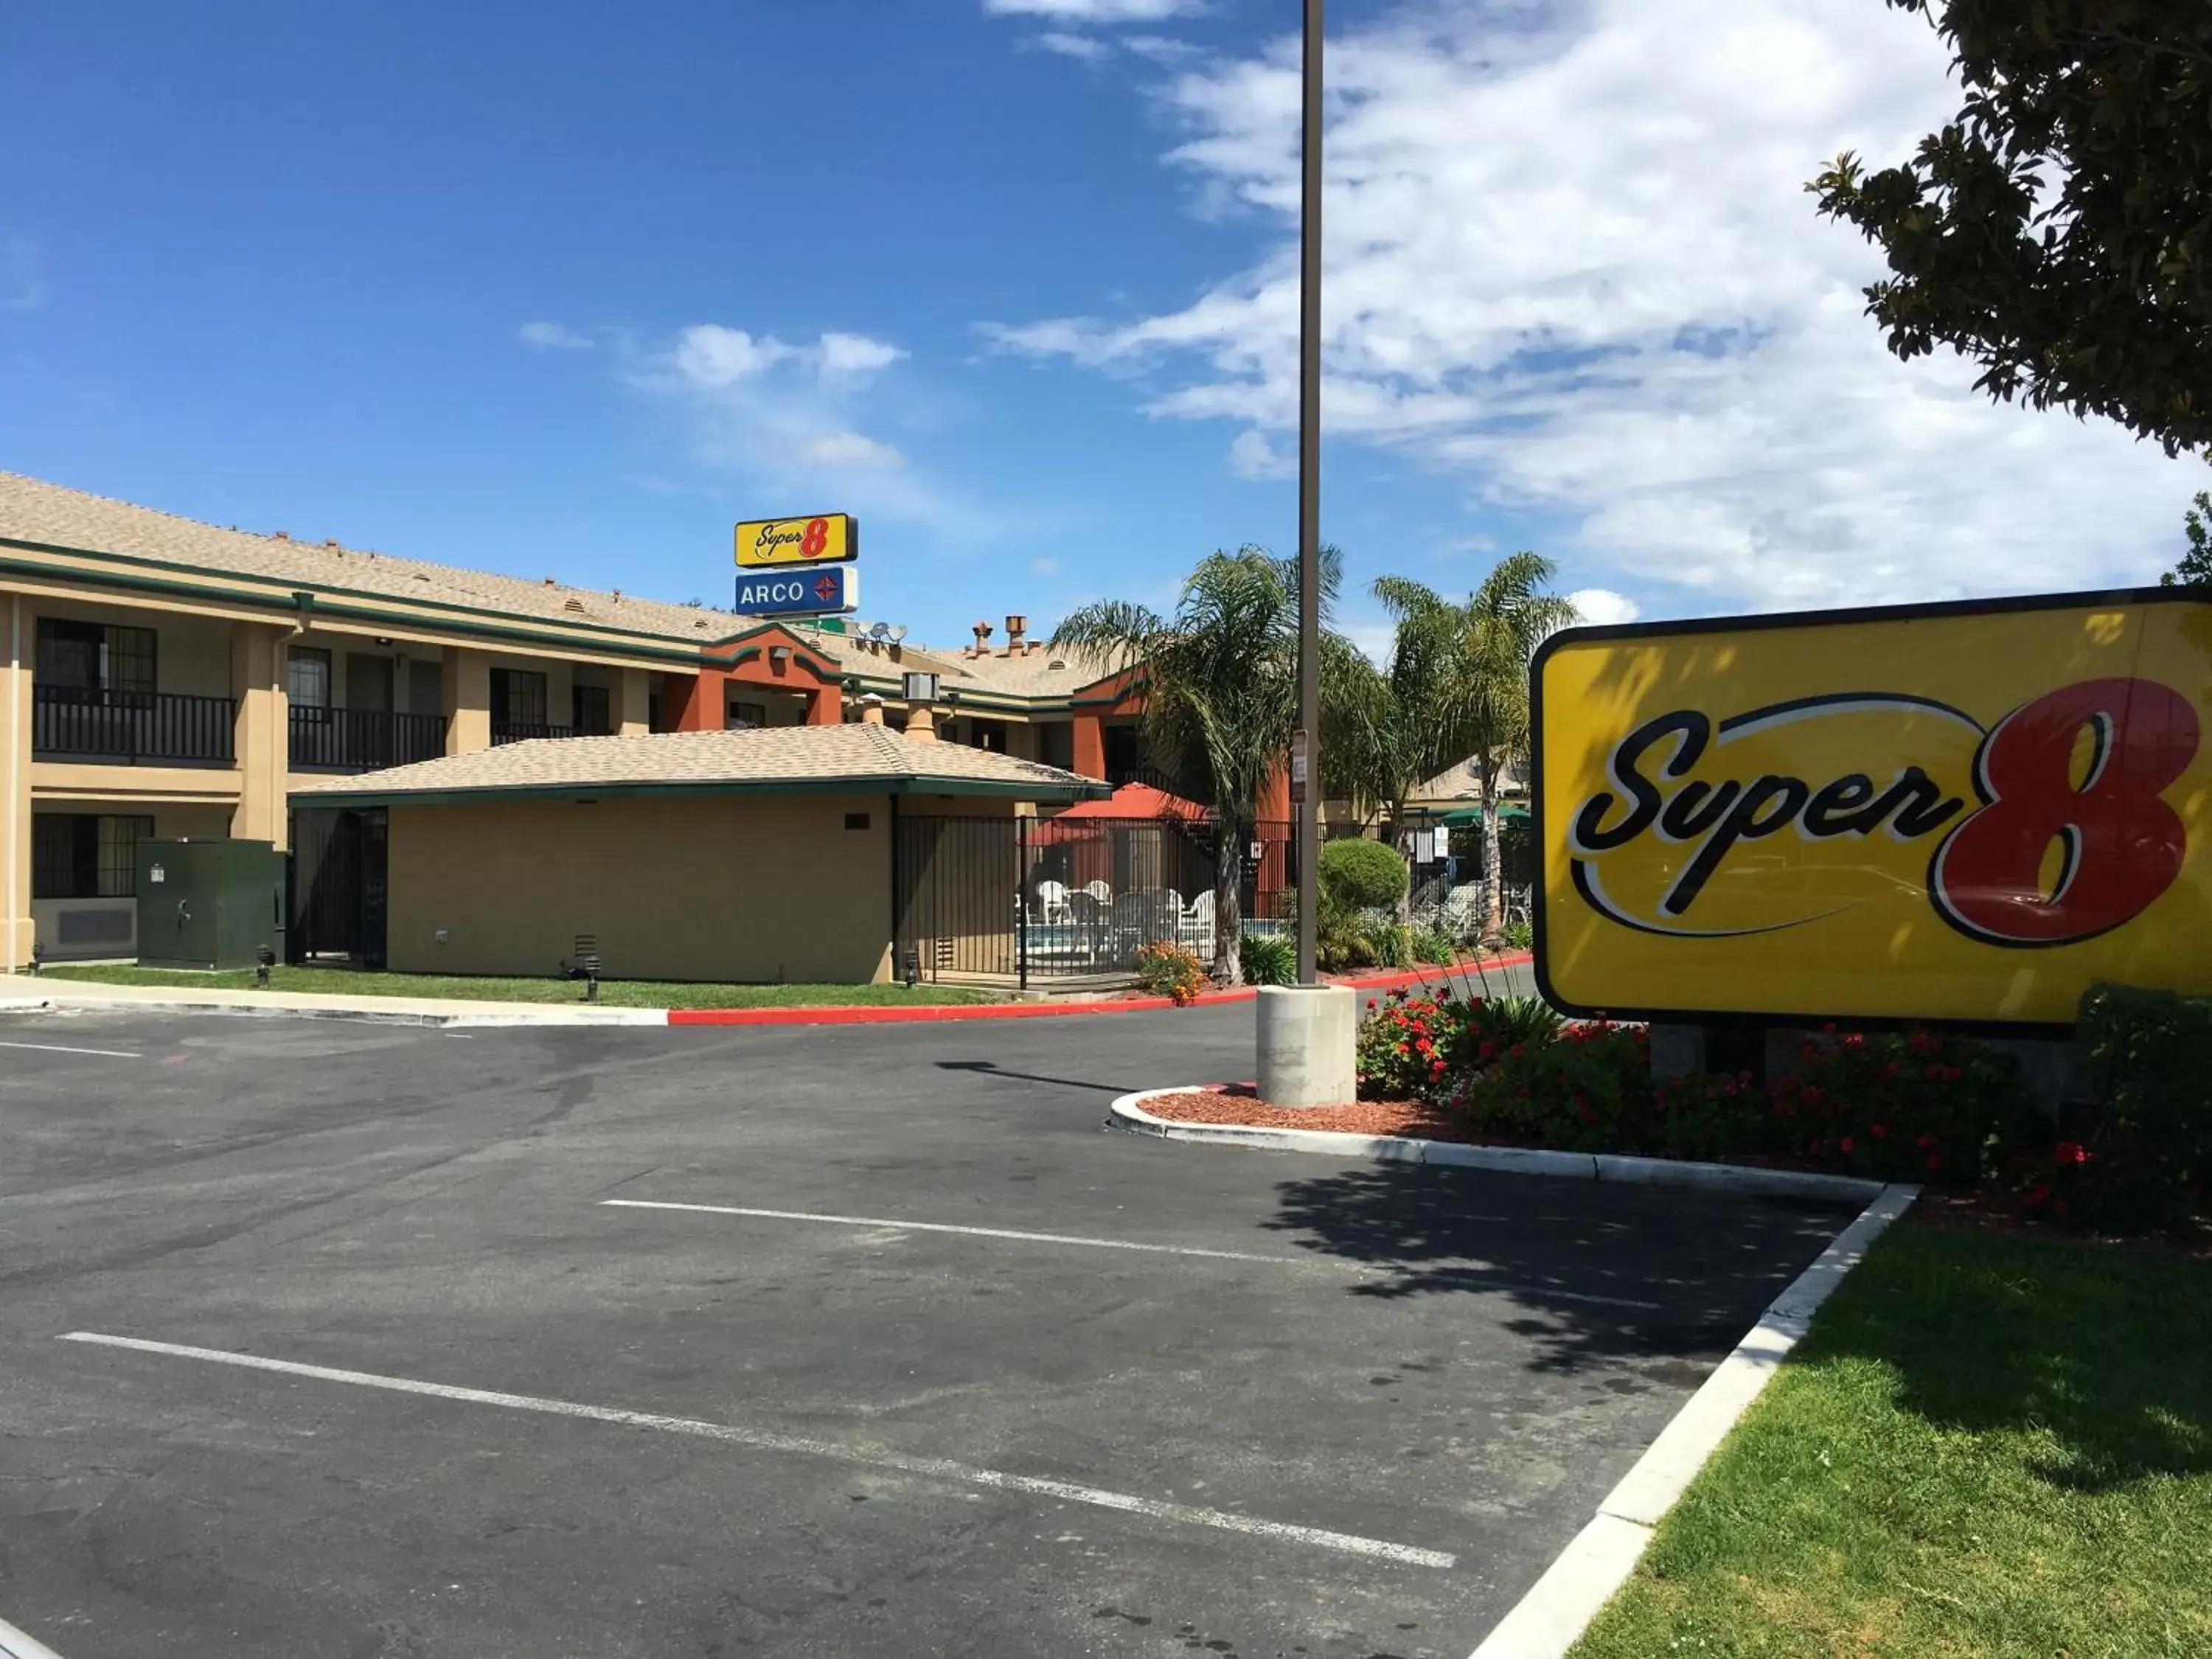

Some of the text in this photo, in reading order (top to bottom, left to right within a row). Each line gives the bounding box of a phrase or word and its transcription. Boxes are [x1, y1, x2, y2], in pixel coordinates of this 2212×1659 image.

[756, 518, 829, 557] Super 8
[740, 582, 804, 605] ARCO
[1570, 676, 2200, 949] Super 8
